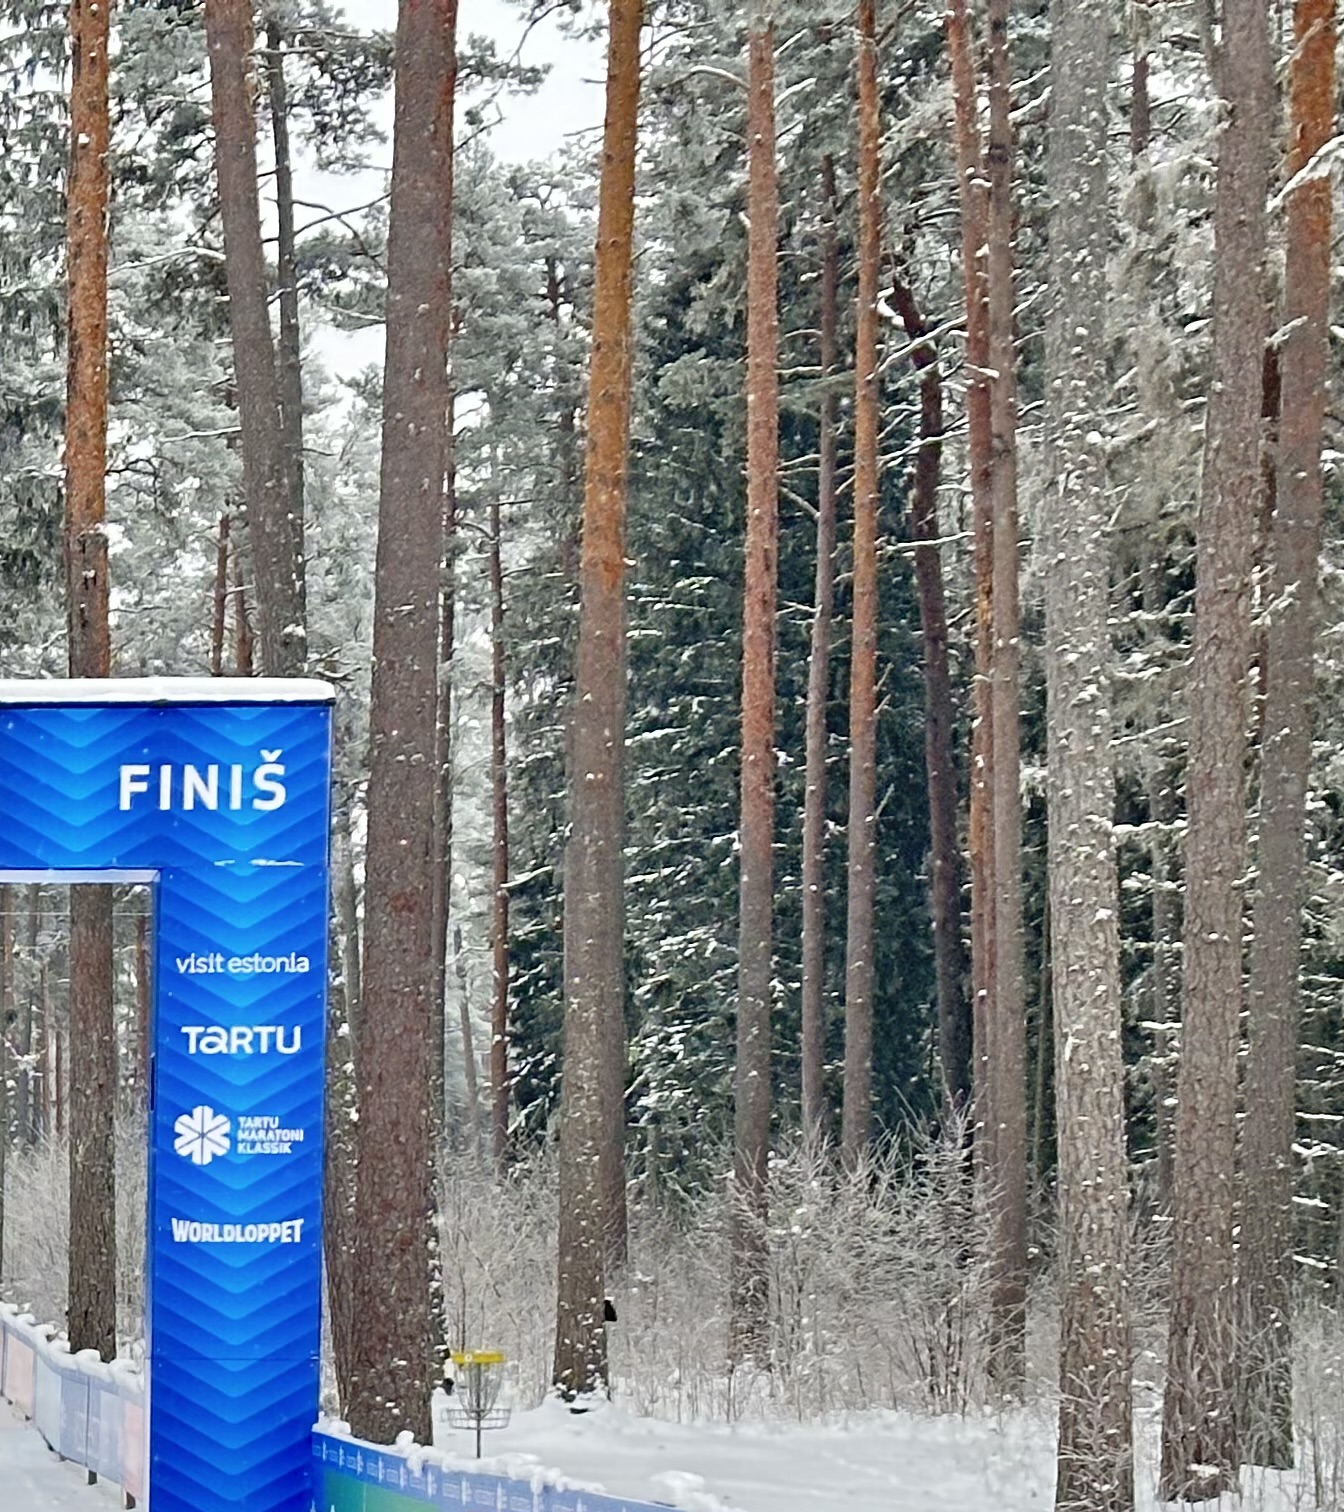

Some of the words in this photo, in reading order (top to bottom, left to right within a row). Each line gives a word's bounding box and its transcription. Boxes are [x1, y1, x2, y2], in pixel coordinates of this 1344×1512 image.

[118, 748, 288, 812] FINIŠ
[175, 951, 224, 973] visit
[227, 952, 310, 973] estonia
[237, 1116, 279, 1129] TARTU
[171, 1217, 305, 1244] WORLDLOPPET
